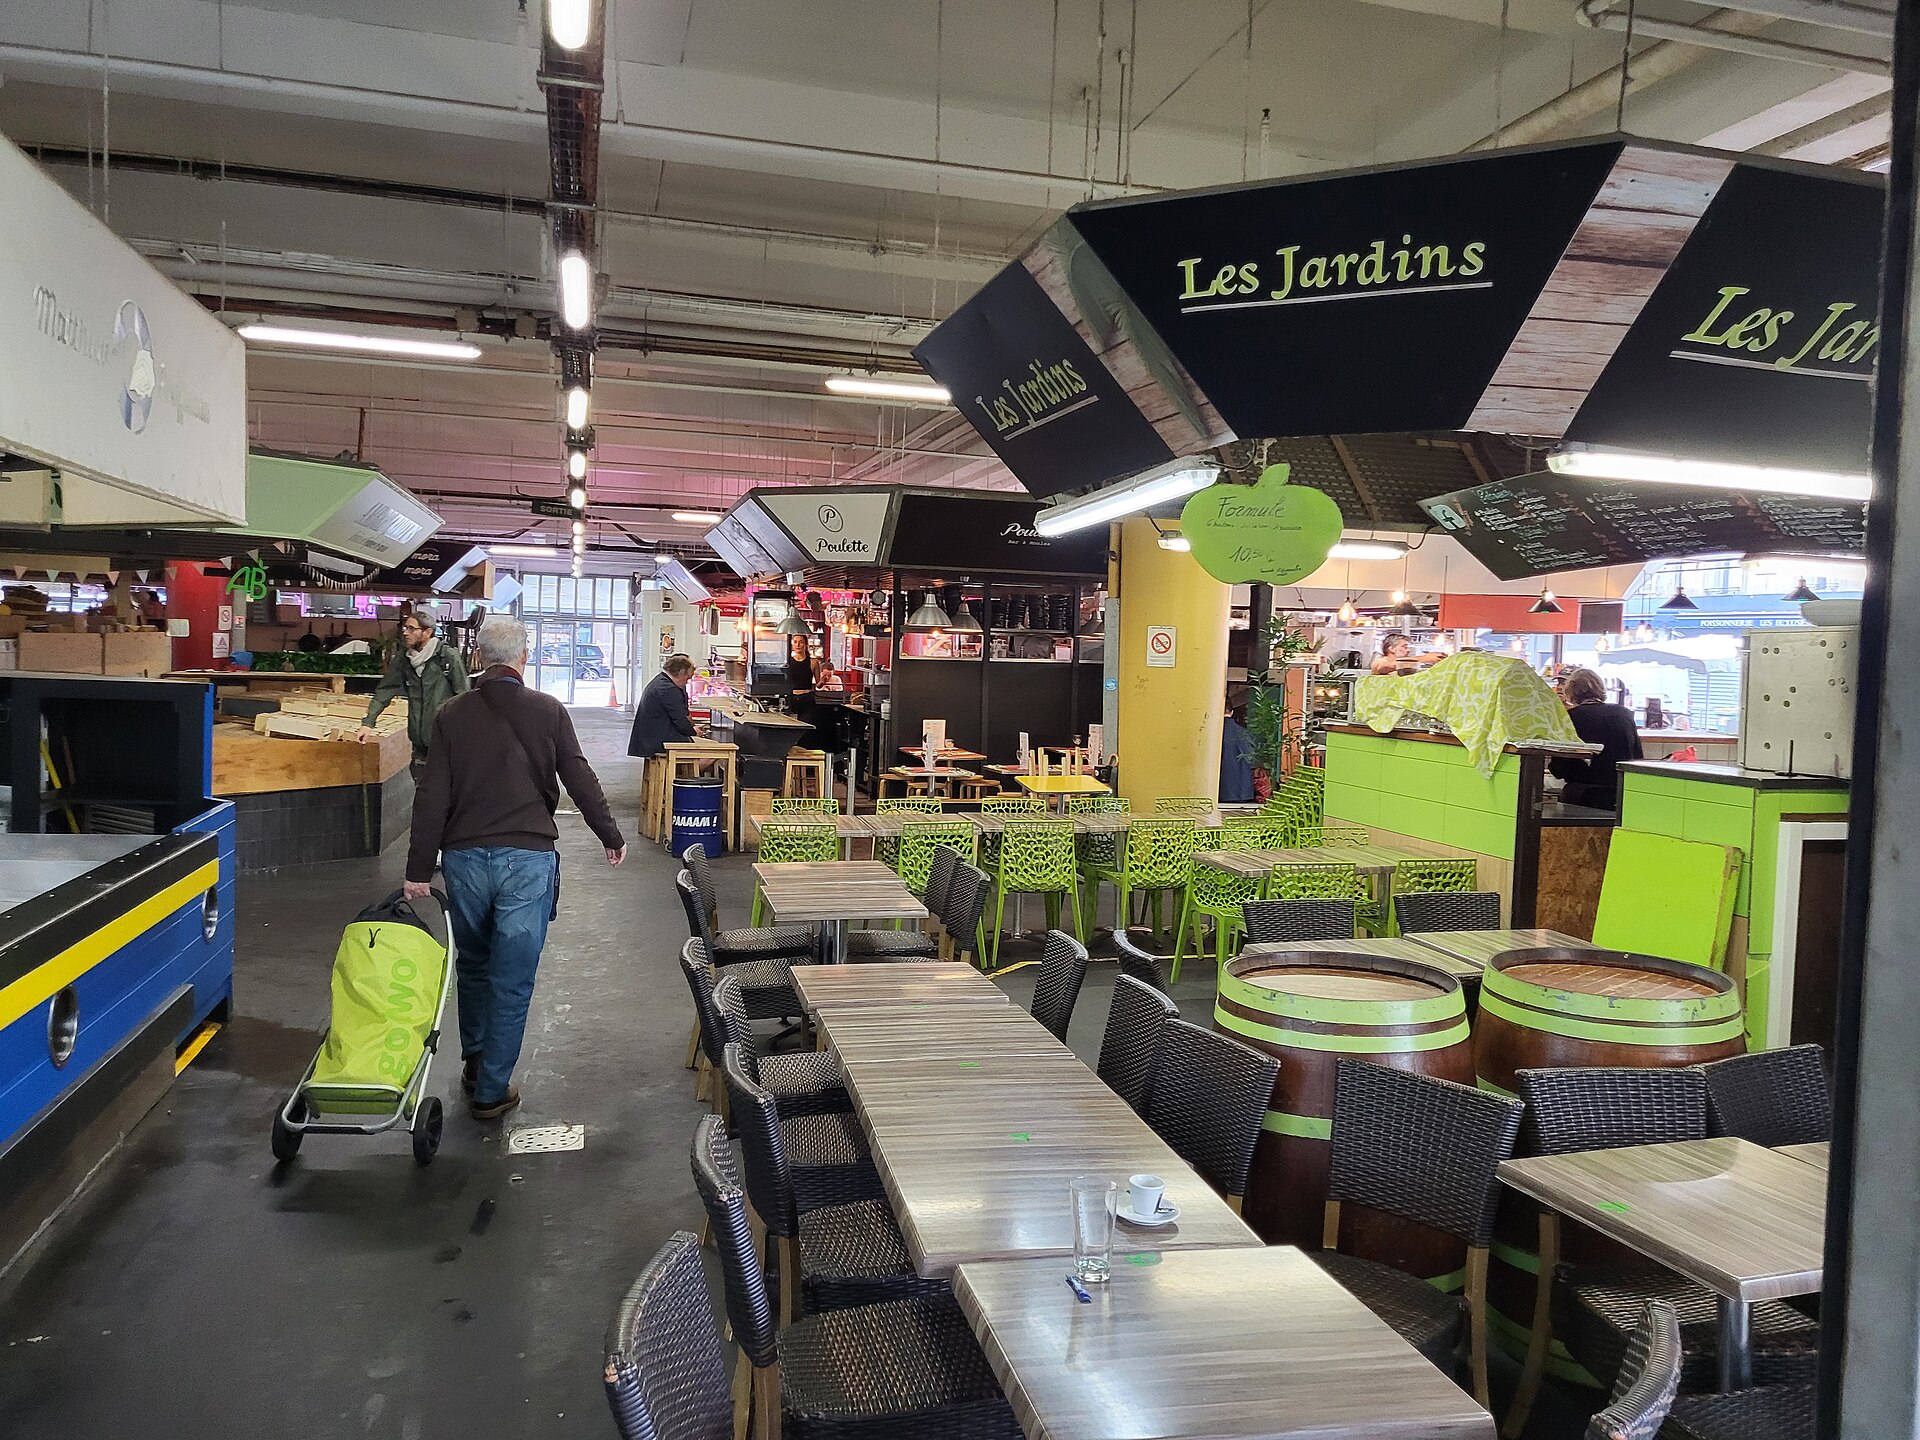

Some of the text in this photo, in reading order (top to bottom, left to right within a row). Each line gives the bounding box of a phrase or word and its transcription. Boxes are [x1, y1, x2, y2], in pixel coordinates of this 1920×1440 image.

[1177, 234, 1486, 300] Les Jardins
[1680, 286, 1880, 370] Les Jar
[975, 358, 1087, 432] Les Jardins
[539, 505, 573, 516] SORTIE
[822, 508, 836, 524] P
[1217, 496, 1285, 519] Formule
[814, 537, 869, 553] Poulette
[225, 564, 268, 600] AB
[1700, 619, 1754, 627] POISSONNERIE
[1759, 619, 1773, 627] LES
